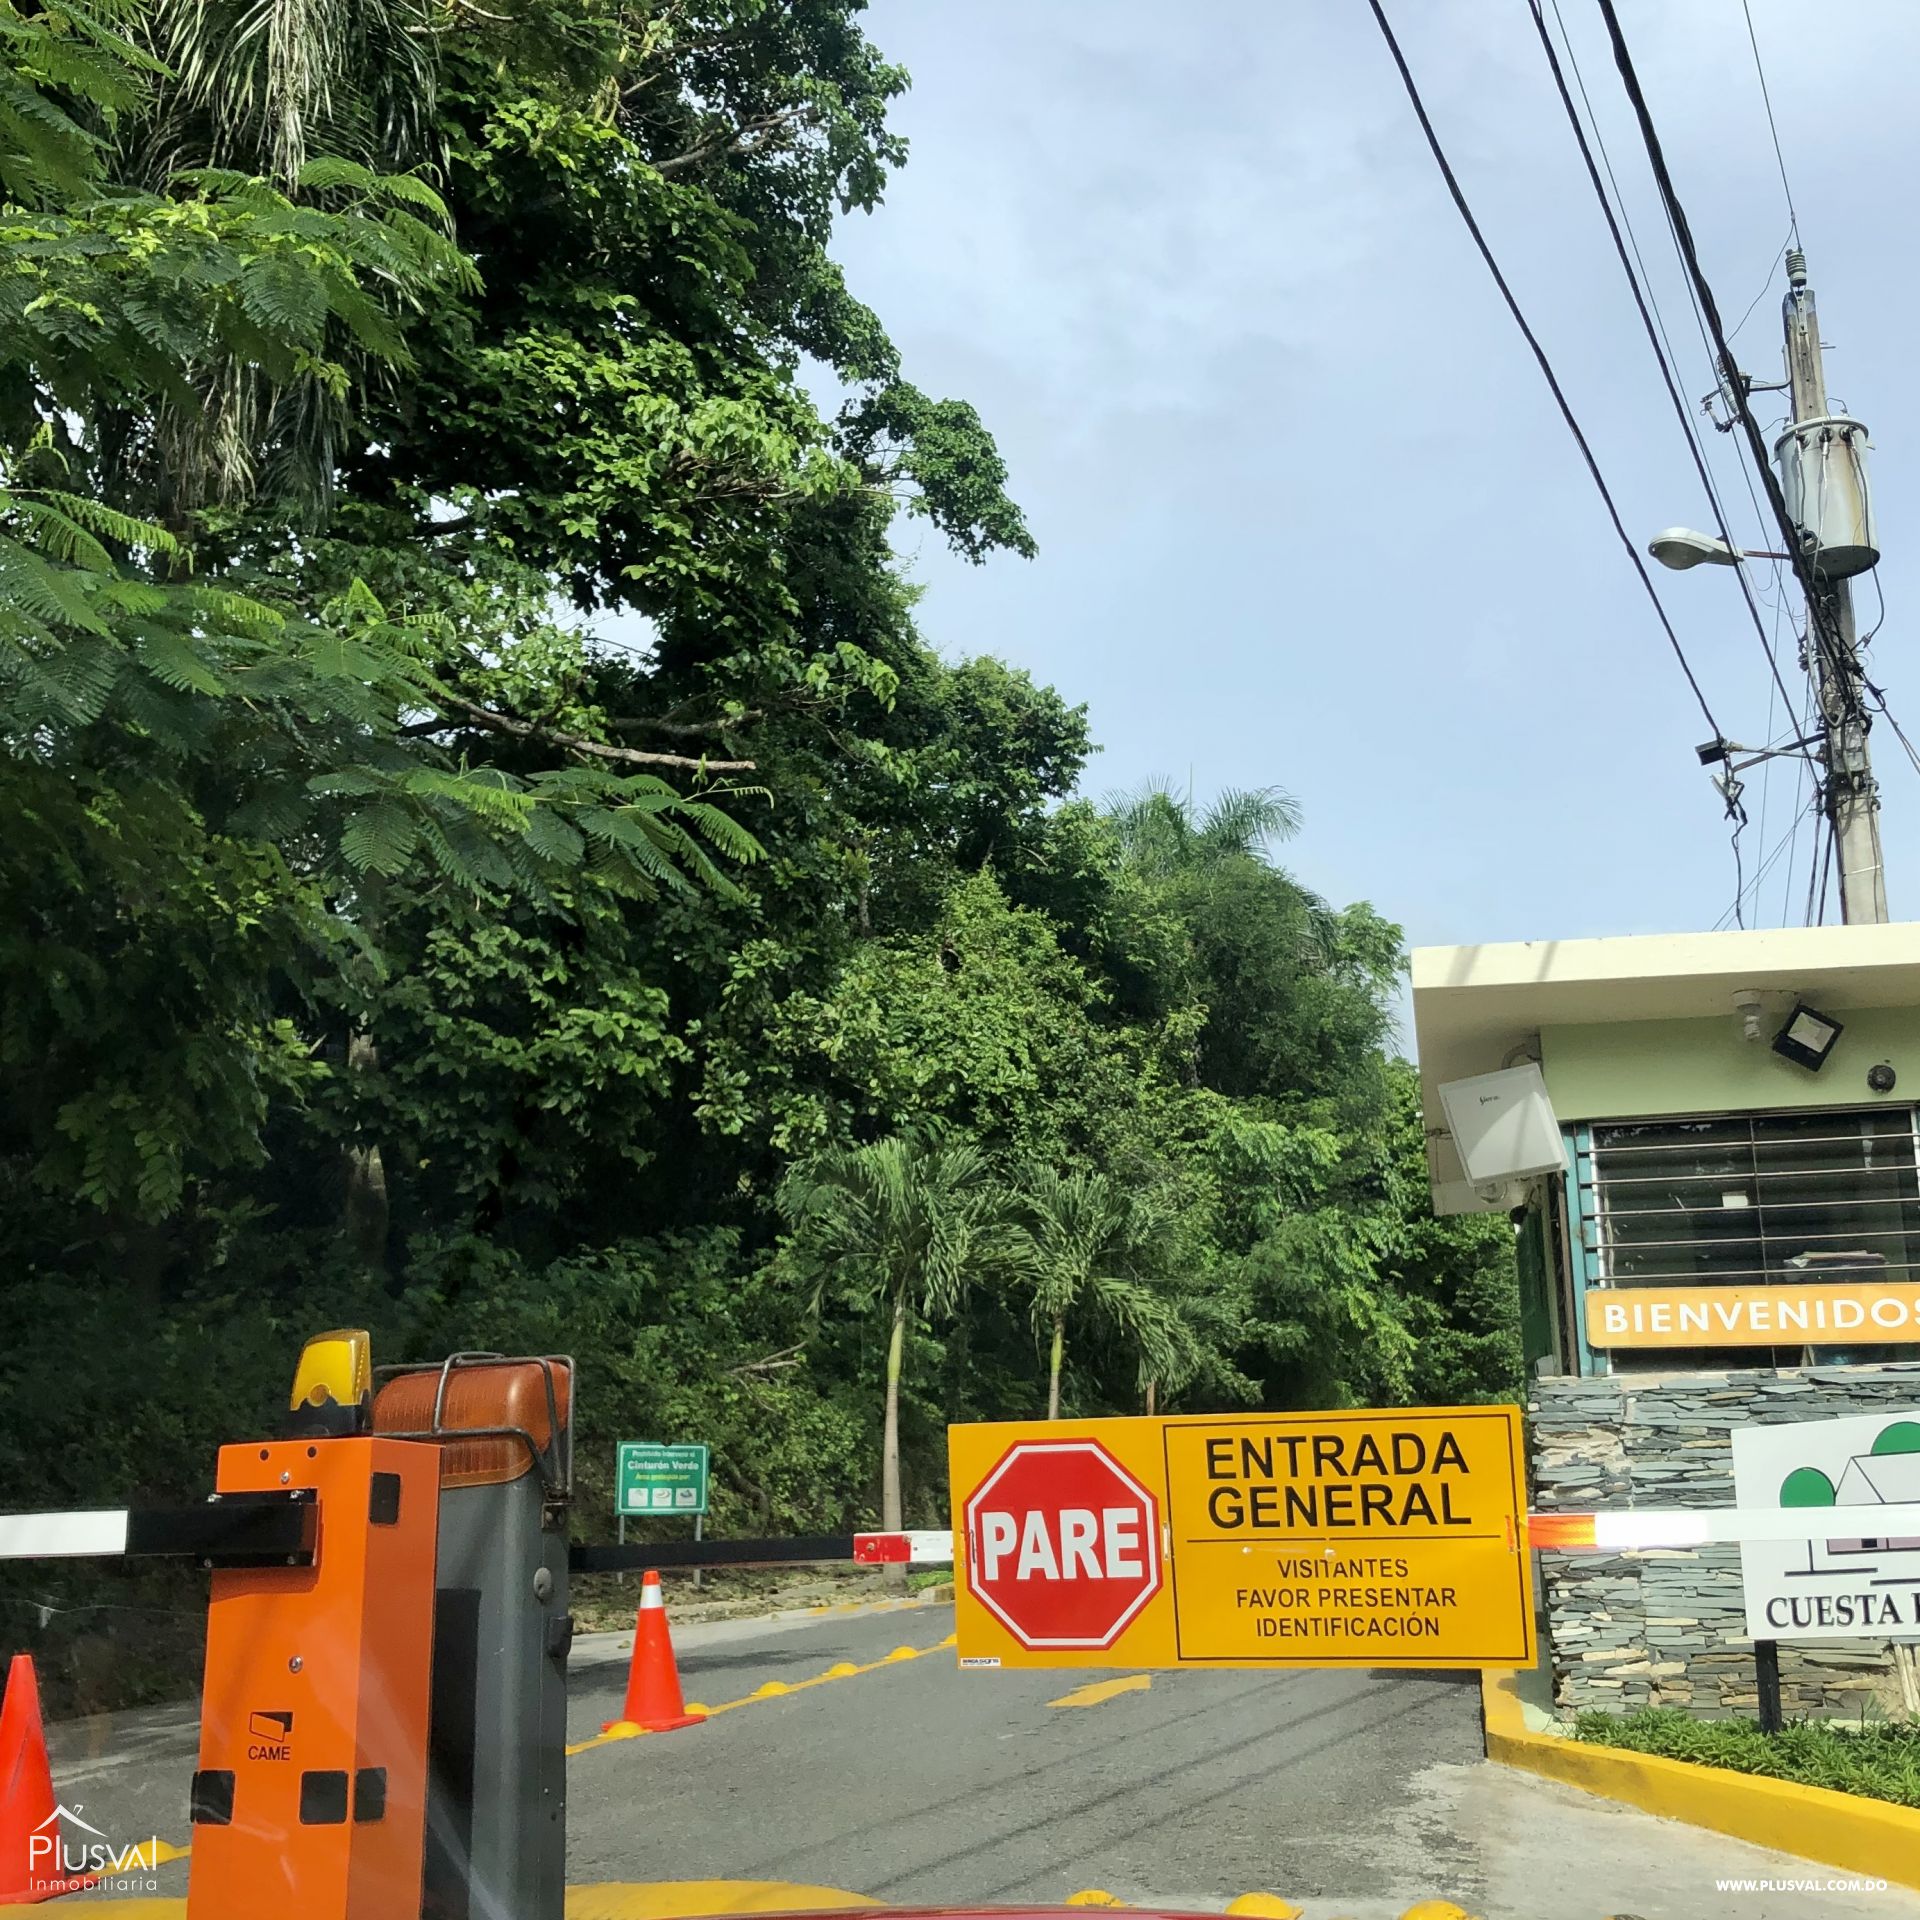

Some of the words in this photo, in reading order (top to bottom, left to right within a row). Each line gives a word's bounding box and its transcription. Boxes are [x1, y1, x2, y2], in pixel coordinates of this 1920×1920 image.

[1206, 1432, 1470, 1480] ENTRADA
[1208, 1482, 1472, 1530] GENERAL
[981, 1507, 1143, 1581] PARE
[1278, 1559, 1408, 1579] VISITANTES
[1237, 1588, 1310, 1608] FAVOR
[1319, 1587, 1457, 1608] PRESENTAR
[1766, 1593, 1904, 1628] CUESTA
[1257, 1611, 1439, 1637] IDENTIFICACIÓN
[248, 1746, 291, 1760] CAME
